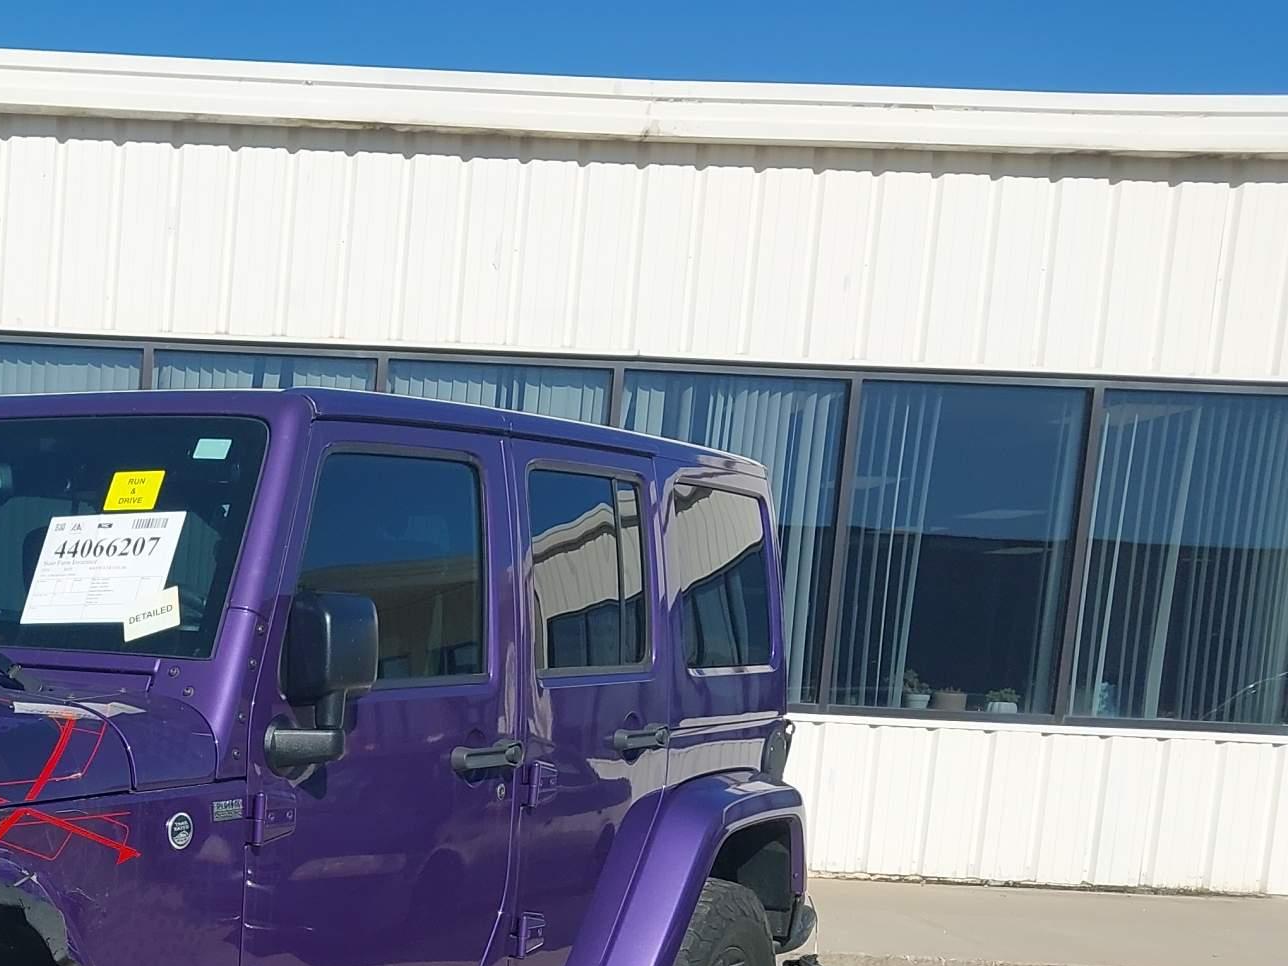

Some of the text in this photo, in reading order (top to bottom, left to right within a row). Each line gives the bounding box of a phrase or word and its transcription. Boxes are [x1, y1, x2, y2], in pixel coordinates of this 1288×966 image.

[130, 487, 136, 495] &
[117, 496, 144, 505] DRIVE
[53, 536, 161, 559] 44066207
[128, 604, 173, 625] DETAILED
